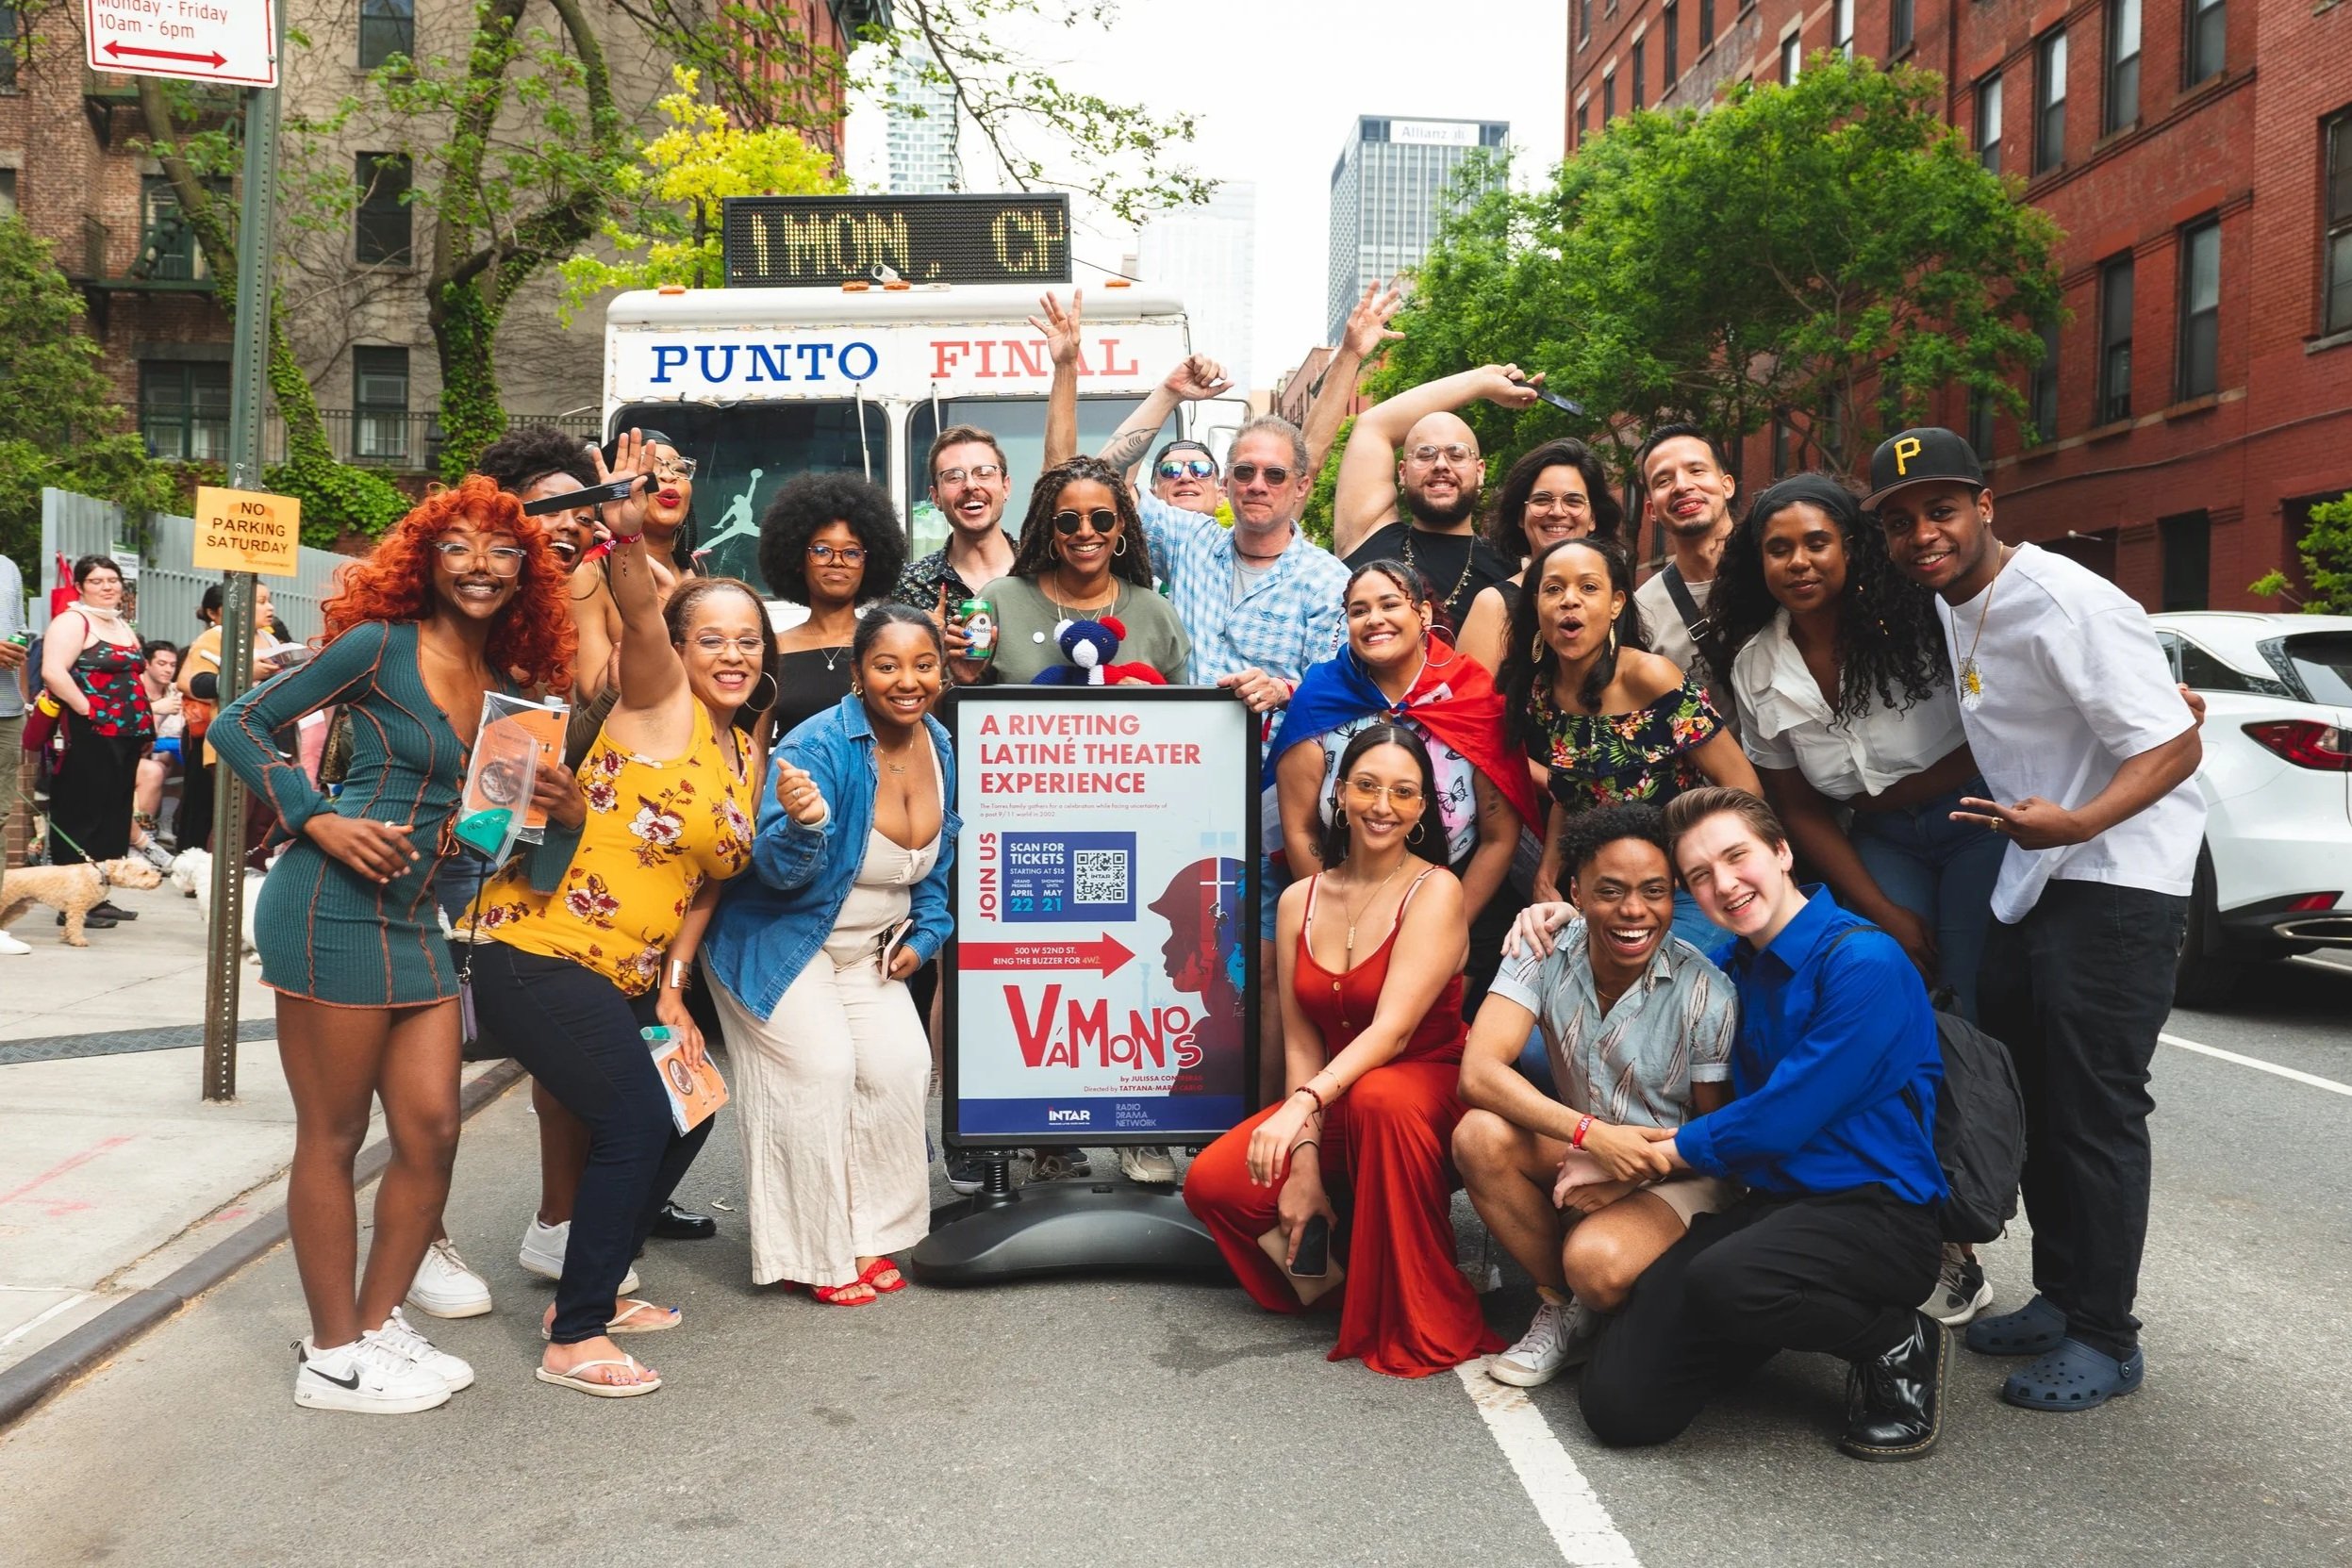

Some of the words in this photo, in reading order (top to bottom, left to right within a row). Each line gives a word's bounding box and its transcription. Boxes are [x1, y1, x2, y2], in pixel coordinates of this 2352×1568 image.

[179, 1, 228, 25] Friday
[99, 14, 141, 33] 10am
[159, 21, 195, 40] 6pm
[1401, 125, 1448, 140] Allianz
[650, 341, 879, 384] PUNTO
[1894, 437, 1922, 475] P
[240, 502, 265, 516] NO
[212, 518, 286, 537] PARKING
[207, 535, 289, 554] SATURDAY
[979, 715, 1001, 735] A
[1008, 715, 1141, 735] RIVETING
[980, 736, 1076, 765] LATINÉ
[1083, 744, 1201, 765] THEATER
[980, 772, 1146, 793] EXPERIENCE
[980, 833, 997, 861] US
[1010, 843, 1040, 852] SCAN
[1043, 843, 1065, 852] FOR
[1010, 853, 1065, 865] TICKETS
[980, 868, 997, 922] JOIN
[1011, 898, 1034, 912] 22
[1041, 898, 1062, 912] 21
[1015, 947, 1030, 955] 500
[993, 957, 1015, 966] RING
[1002, 983, 1203, 1070] VÁMONOS
[1049, 1108, 1090, 1121] INTAR
[1116, 1111, 1148, 1119] DRAMA
[1116, 1119, 1157, 1128] NETWORK
[1579, 1117, 1592, 1131] VIP
